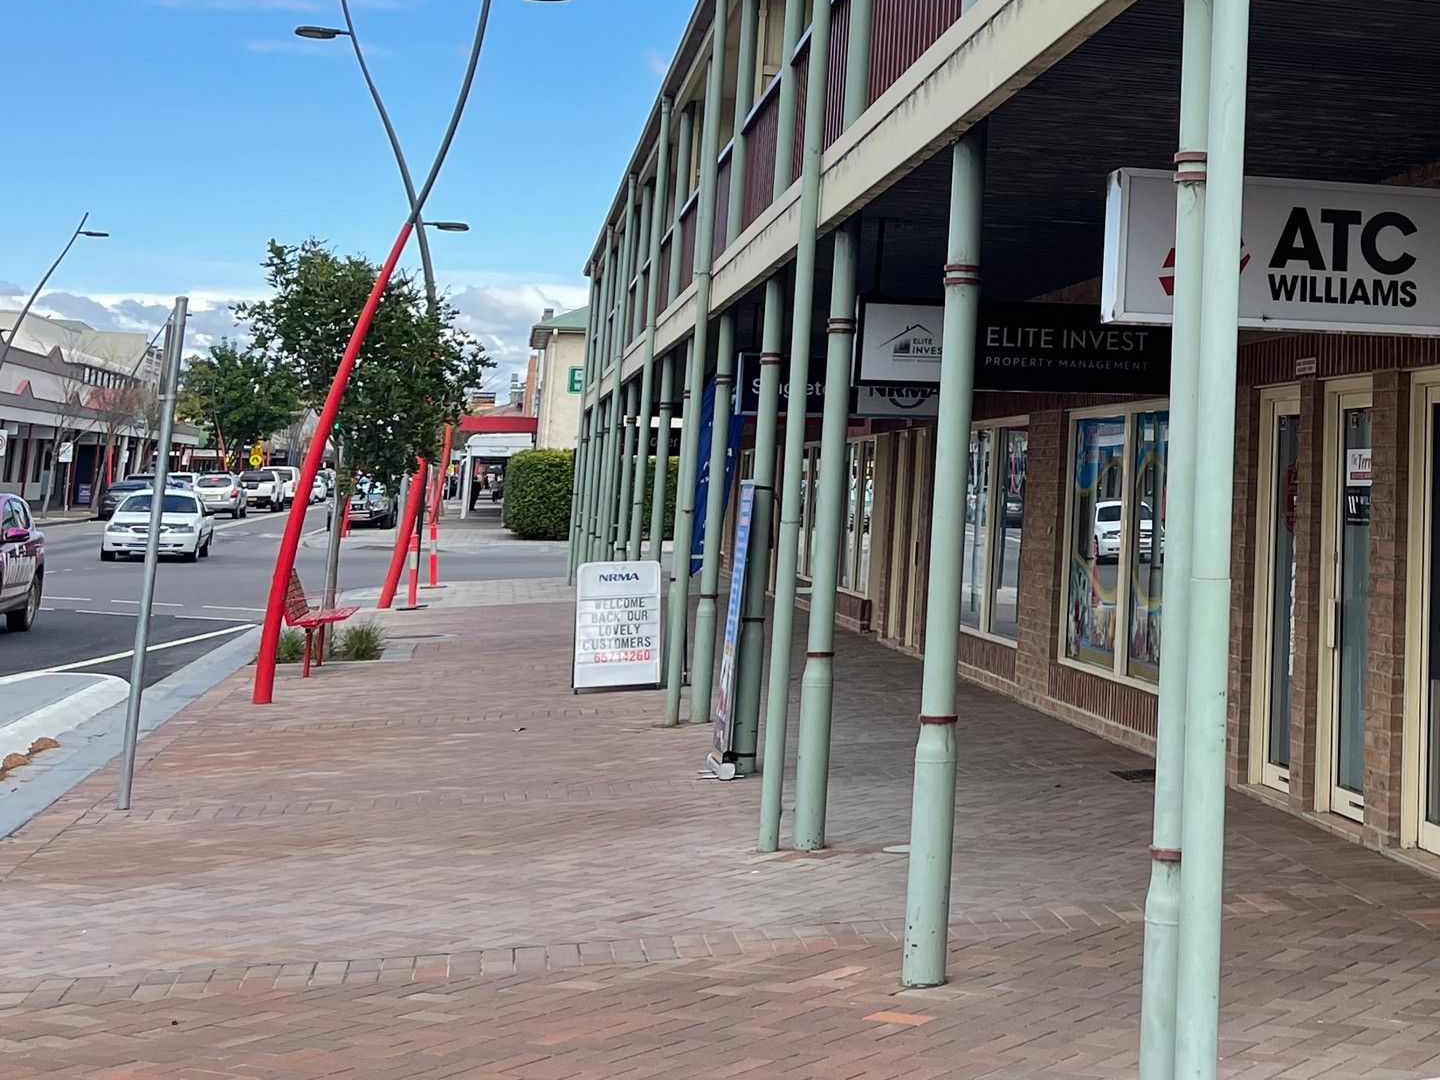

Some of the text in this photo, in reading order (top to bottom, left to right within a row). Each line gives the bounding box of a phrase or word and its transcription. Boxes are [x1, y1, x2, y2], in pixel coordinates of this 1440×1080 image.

[1268, 206, 1418, 276] ATC
[1268, 273, 1418, 308] WILLIAMS
[912, 337, 933, 345] ELITE
[986, 326, 1149, 351] ELITE INVEST
[912, 346, 943, 355] INVES
[985, 356, 1149, 370] PROPERTY MANAGEMENT
[599, 572, 640, 582] NRMA
[594, 597, 646, 610] WELCOME
[591, 610, 648, 624] BACK OUR
[598, 623, 641, 637] LOVELY
[582, 636, 651, 651] CUSTOMERS
